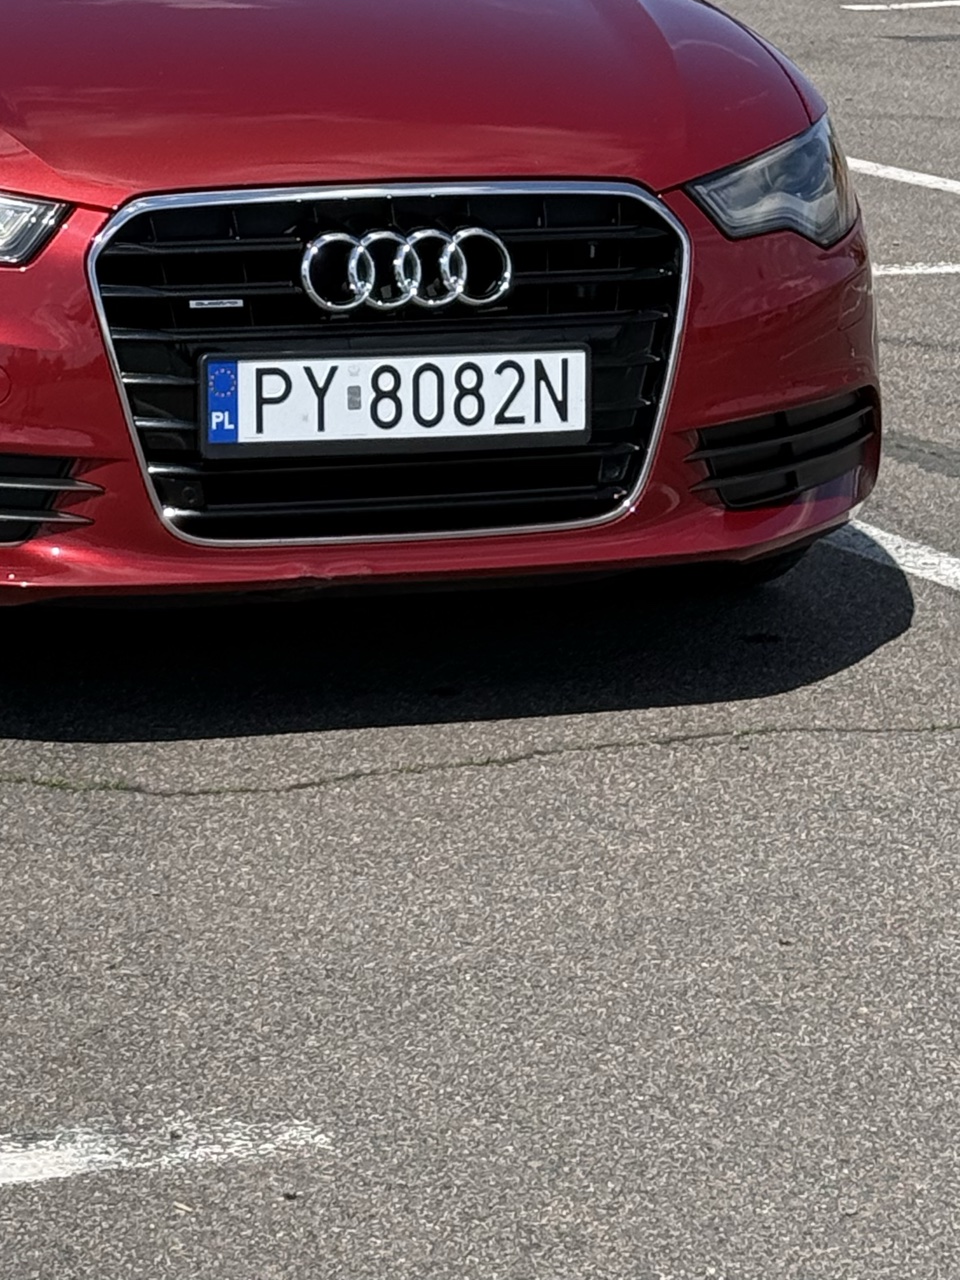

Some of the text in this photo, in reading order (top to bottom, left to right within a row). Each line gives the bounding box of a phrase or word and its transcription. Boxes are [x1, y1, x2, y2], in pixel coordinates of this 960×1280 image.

[254, 357, 570, 435] PY 8082N
[211, 411, 234, 431] PL
